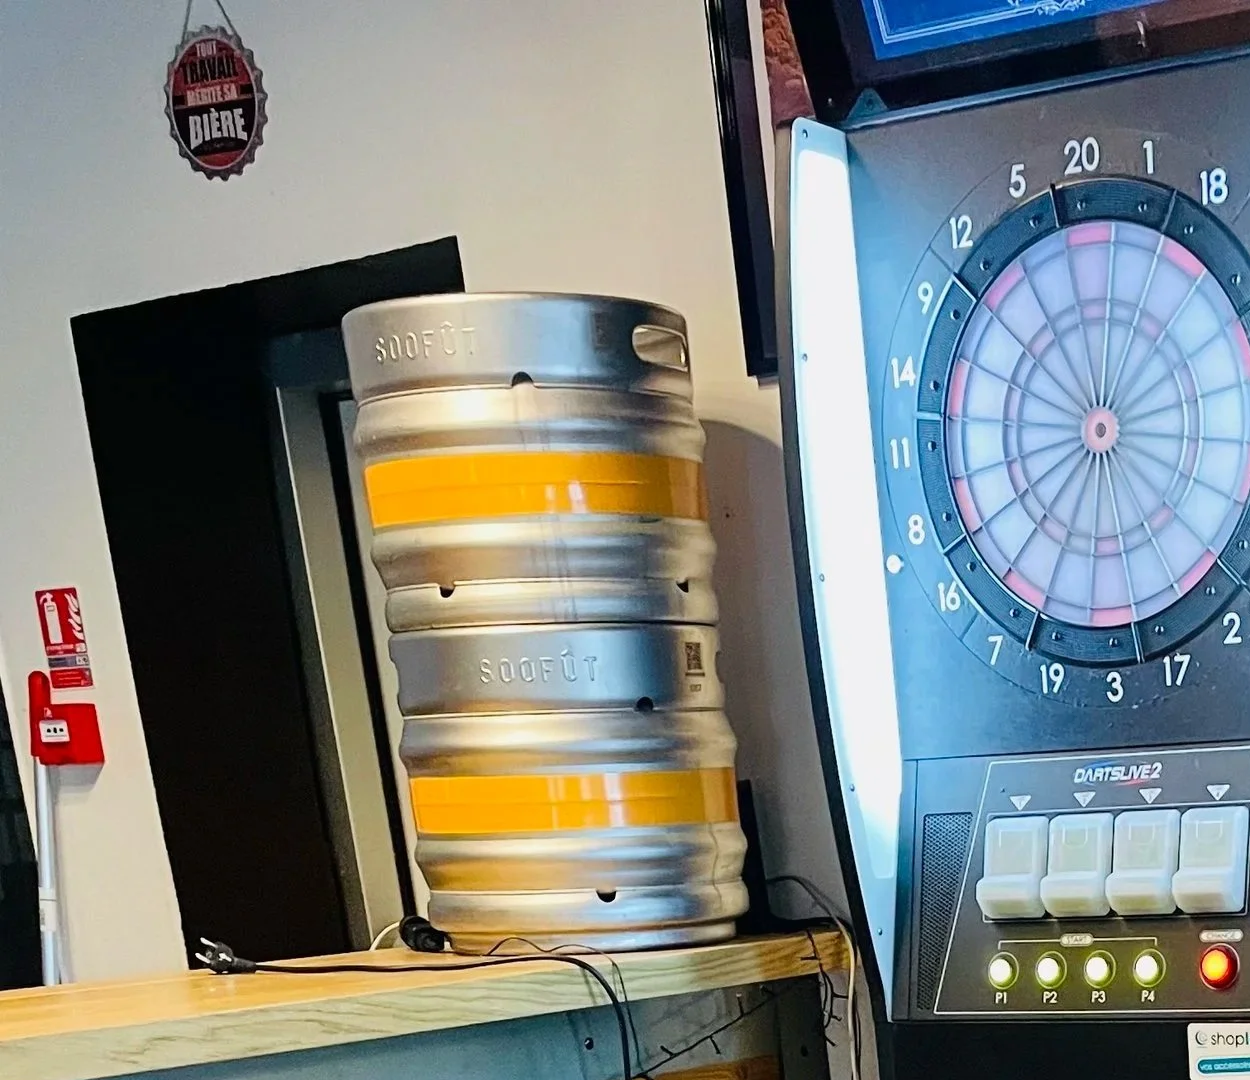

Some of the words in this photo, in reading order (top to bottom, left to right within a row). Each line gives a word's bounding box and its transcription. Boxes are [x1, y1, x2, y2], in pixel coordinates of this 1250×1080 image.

[195, 40, 217, 58] TOUT
[183, 55, 238, 85] TRAVAIL
[223, 83, 238, 100] SA
[188, 107, 248, 150] BIÈRE
[1063, 136, 1100, 176] 20
[1142, 140, 1154, 174] 1
[1009, 163, 1026, 198] 5
[1200, 167, 1228, 206] 18
[949, 215, 974, 250] 12
[917, 284, 934, 316] 9
[375, 320, 475, 364] SOOFÛT
[891, 355, 916, 389] 14
[890, 440, 911, 469] 11
[908, 514, 926, 545] 8
[937, 581, 961, 612] 16
[1222, 612, 1242, 645] 2
[479, 648, 598, 684] SOOFÛT
[987, 635, 1003, 666] 7
[1039, 662, 1065, 694] 19
[1163, 652, 1191, 687] 17
[1106, 671, 1124, 703] 3
[1073, 761, 1163, 784] DARTSLIVE2
[995, 992, 1007, 1004] P1
[1043, 991, 1058, 1004] P2
[1091, 991, 1106, 1003] P3
[1141, 990, 1155, 1002] P4
